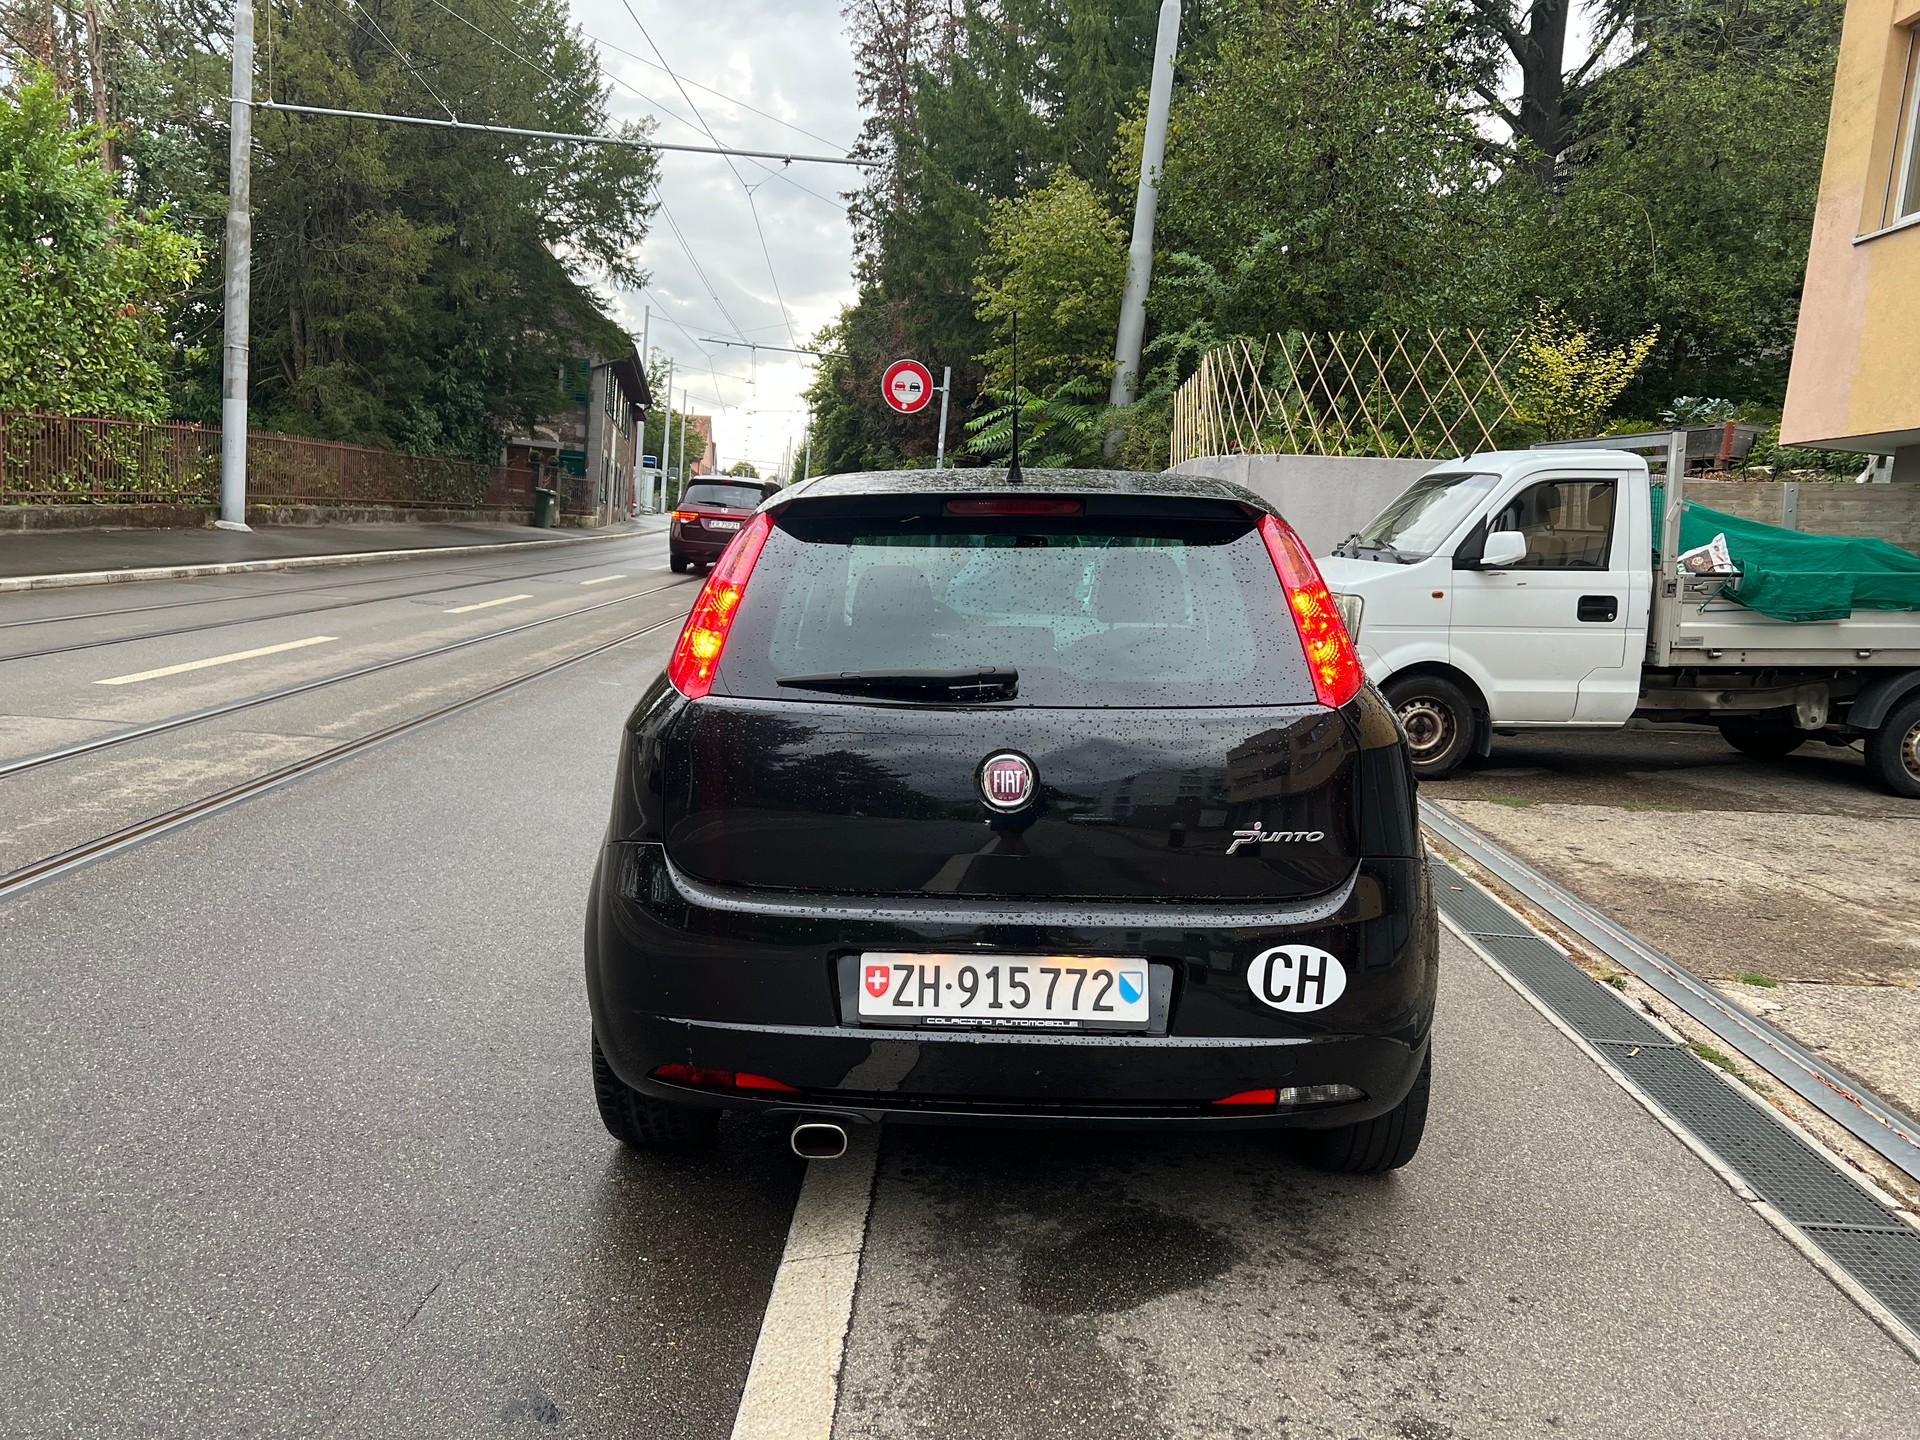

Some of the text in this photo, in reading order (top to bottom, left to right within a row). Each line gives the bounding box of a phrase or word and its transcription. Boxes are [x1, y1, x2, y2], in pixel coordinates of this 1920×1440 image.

[993, 770, 1023, 793] FIAT
[1263, 952, 1327, 1005] CH
[995, 1018, 1079, 1028] AUTOMOBILE
